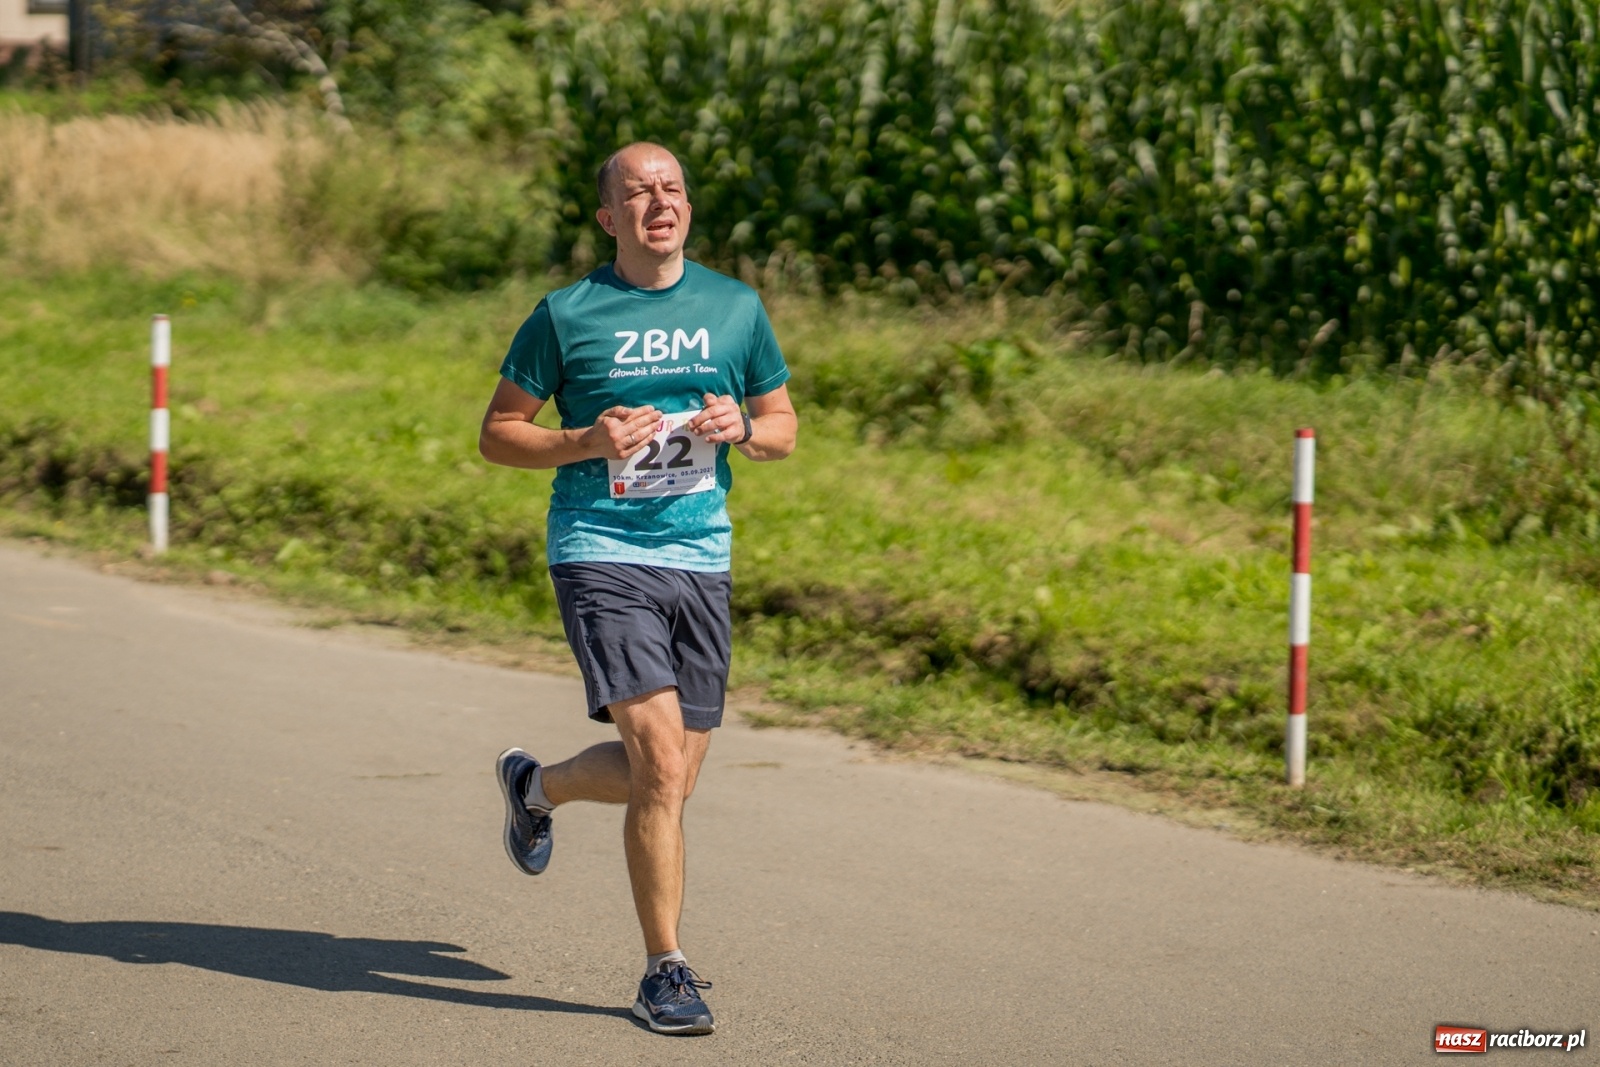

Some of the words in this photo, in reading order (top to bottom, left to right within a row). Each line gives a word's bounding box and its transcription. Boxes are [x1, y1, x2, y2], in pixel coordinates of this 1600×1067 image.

[614, 327, 709, 363] ZBM
[651, 365, 691, 375] Runners
[693, 363, 718, 373] Team
[634, 435, 693, 470] 22
[680, 466, 713, 476] 05.09.2021
